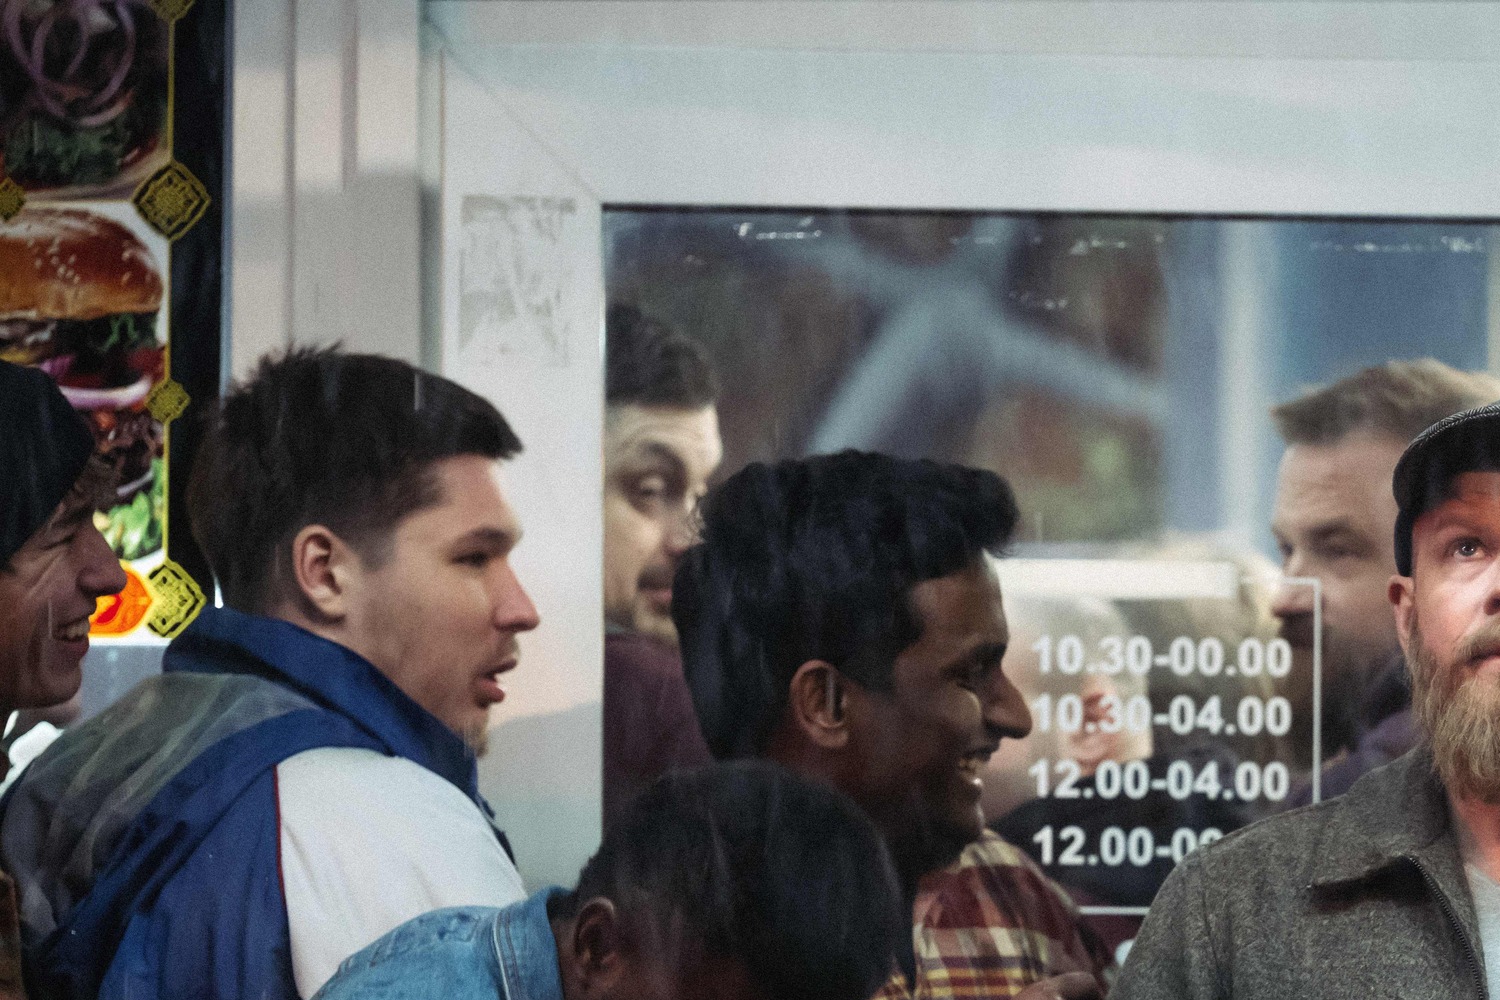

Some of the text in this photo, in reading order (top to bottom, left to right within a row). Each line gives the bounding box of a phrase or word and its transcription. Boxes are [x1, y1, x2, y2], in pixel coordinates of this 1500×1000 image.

[1032, 635, 1293, 677] 10.30-00.00
[1031, 694, 1293, 736] 10.30-04.00
[1028, 758, 1290, 801] 12.00-04.00
